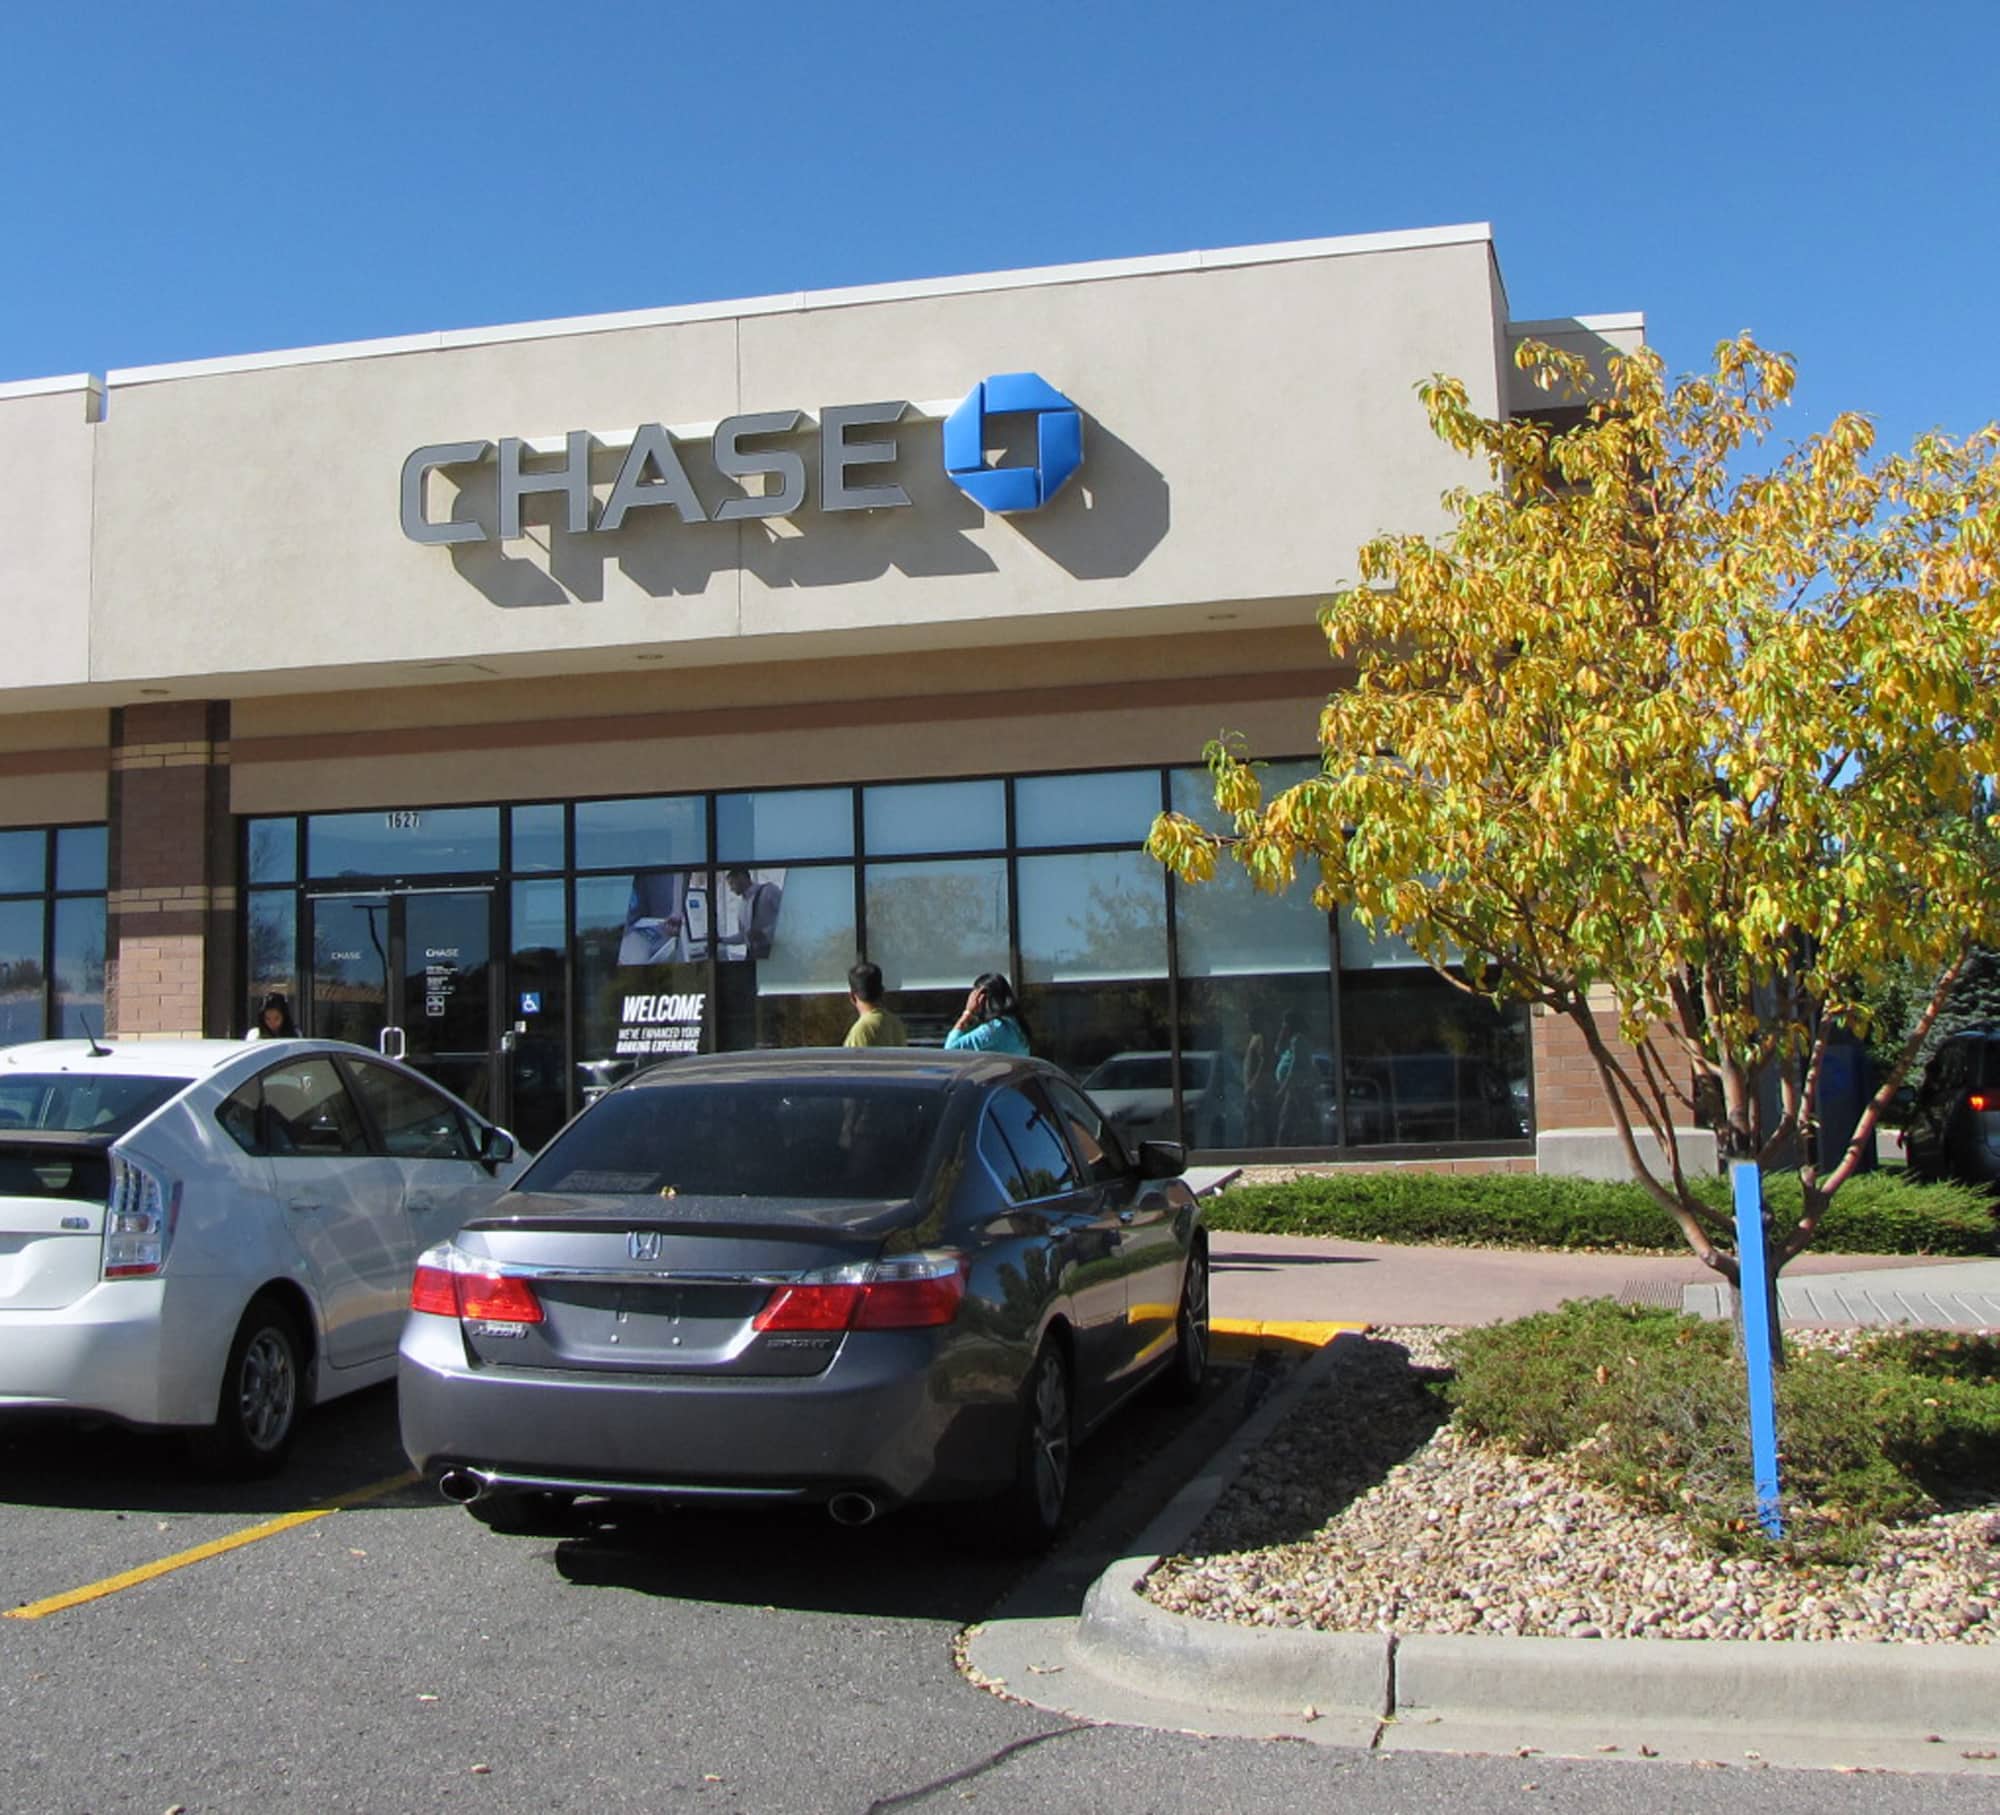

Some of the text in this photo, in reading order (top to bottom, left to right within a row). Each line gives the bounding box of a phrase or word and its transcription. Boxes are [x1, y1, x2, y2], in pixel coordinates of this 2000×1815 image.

[400, 400, 913, 545] CHASE
[388, 811, 419, 829] 1627
[331, 951, 361, 961] CHASE
[425, 948, 459, 958] CHASE
[622, 993, 706, 1023] WELCOME
